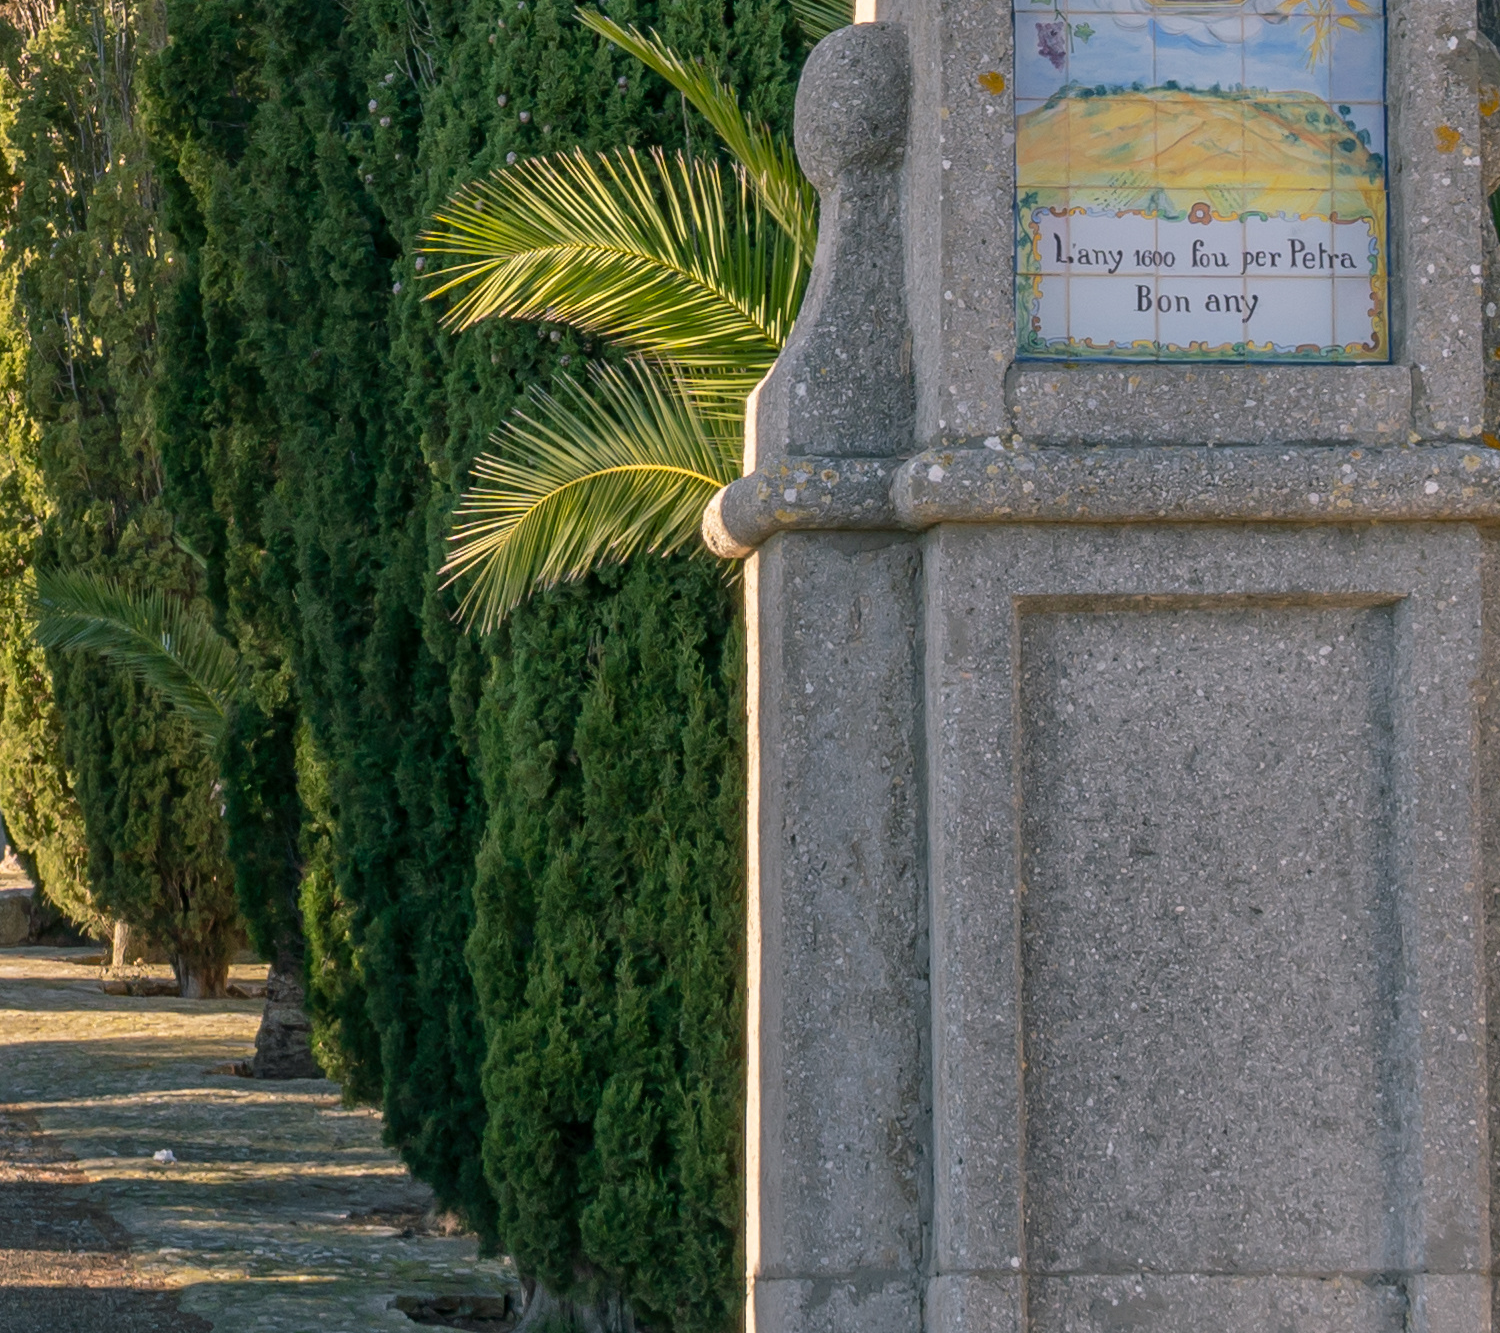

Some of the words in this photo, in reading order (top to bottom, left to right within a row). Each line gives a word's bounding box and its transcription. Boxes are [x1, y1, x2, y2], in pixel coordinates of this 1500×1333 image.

[1053, 232, 1124, 274] L'any
[1133, 248, 1176, 268] 1600
[1191, 239, 1230, 269] fou
[1240, 248, 1282, 276] per
[1287, 237, 1358, 270] Petra
[1134, 284, 1192, 313] Bon
[1205, 292, 1260, 323] any
